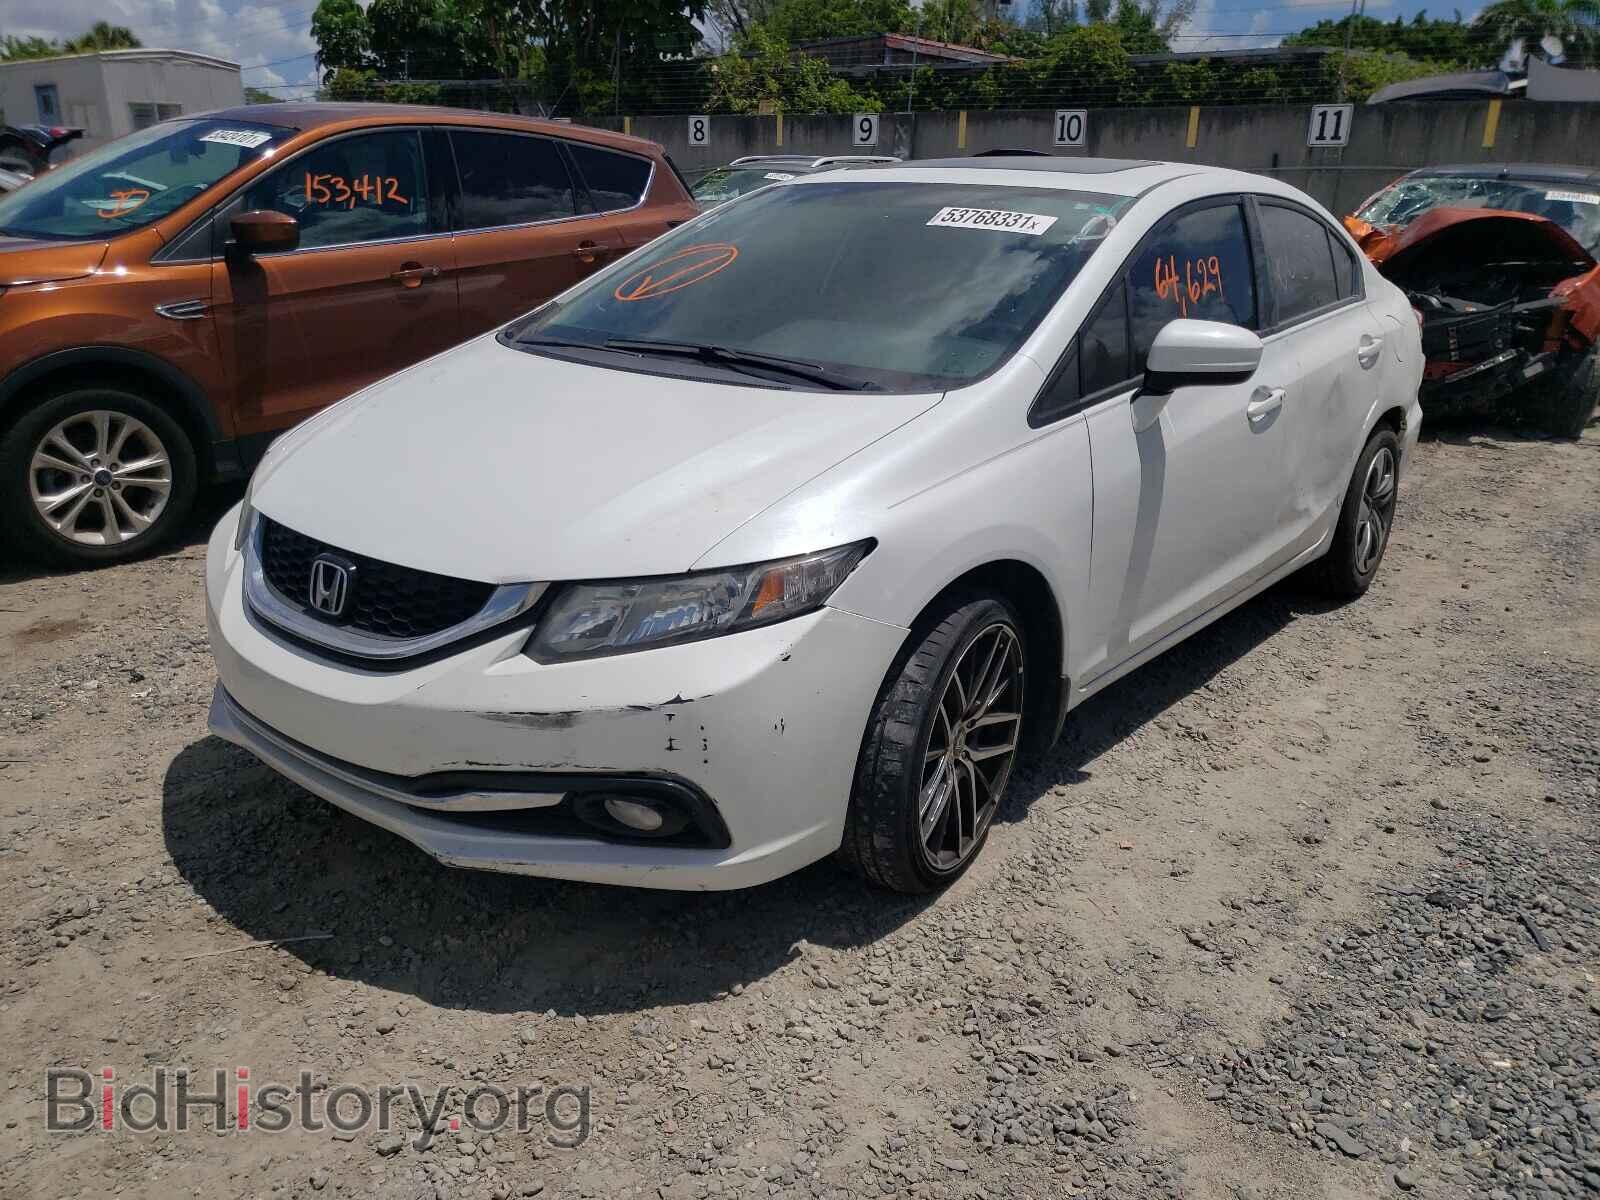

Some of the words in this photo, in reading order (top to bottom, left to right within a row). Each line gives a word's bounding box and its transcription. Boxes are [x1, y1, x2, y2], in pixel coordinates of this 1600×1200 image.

[692, 119, 705, 142] 8
[858, 117, 873, 142] 9
[1056, 114, 1082, 142] 10
[1314, 109, 1343, 141] 11
[305, 172, 408, 209] 153,412
[1155, 255, 1224, 319] 64,629
